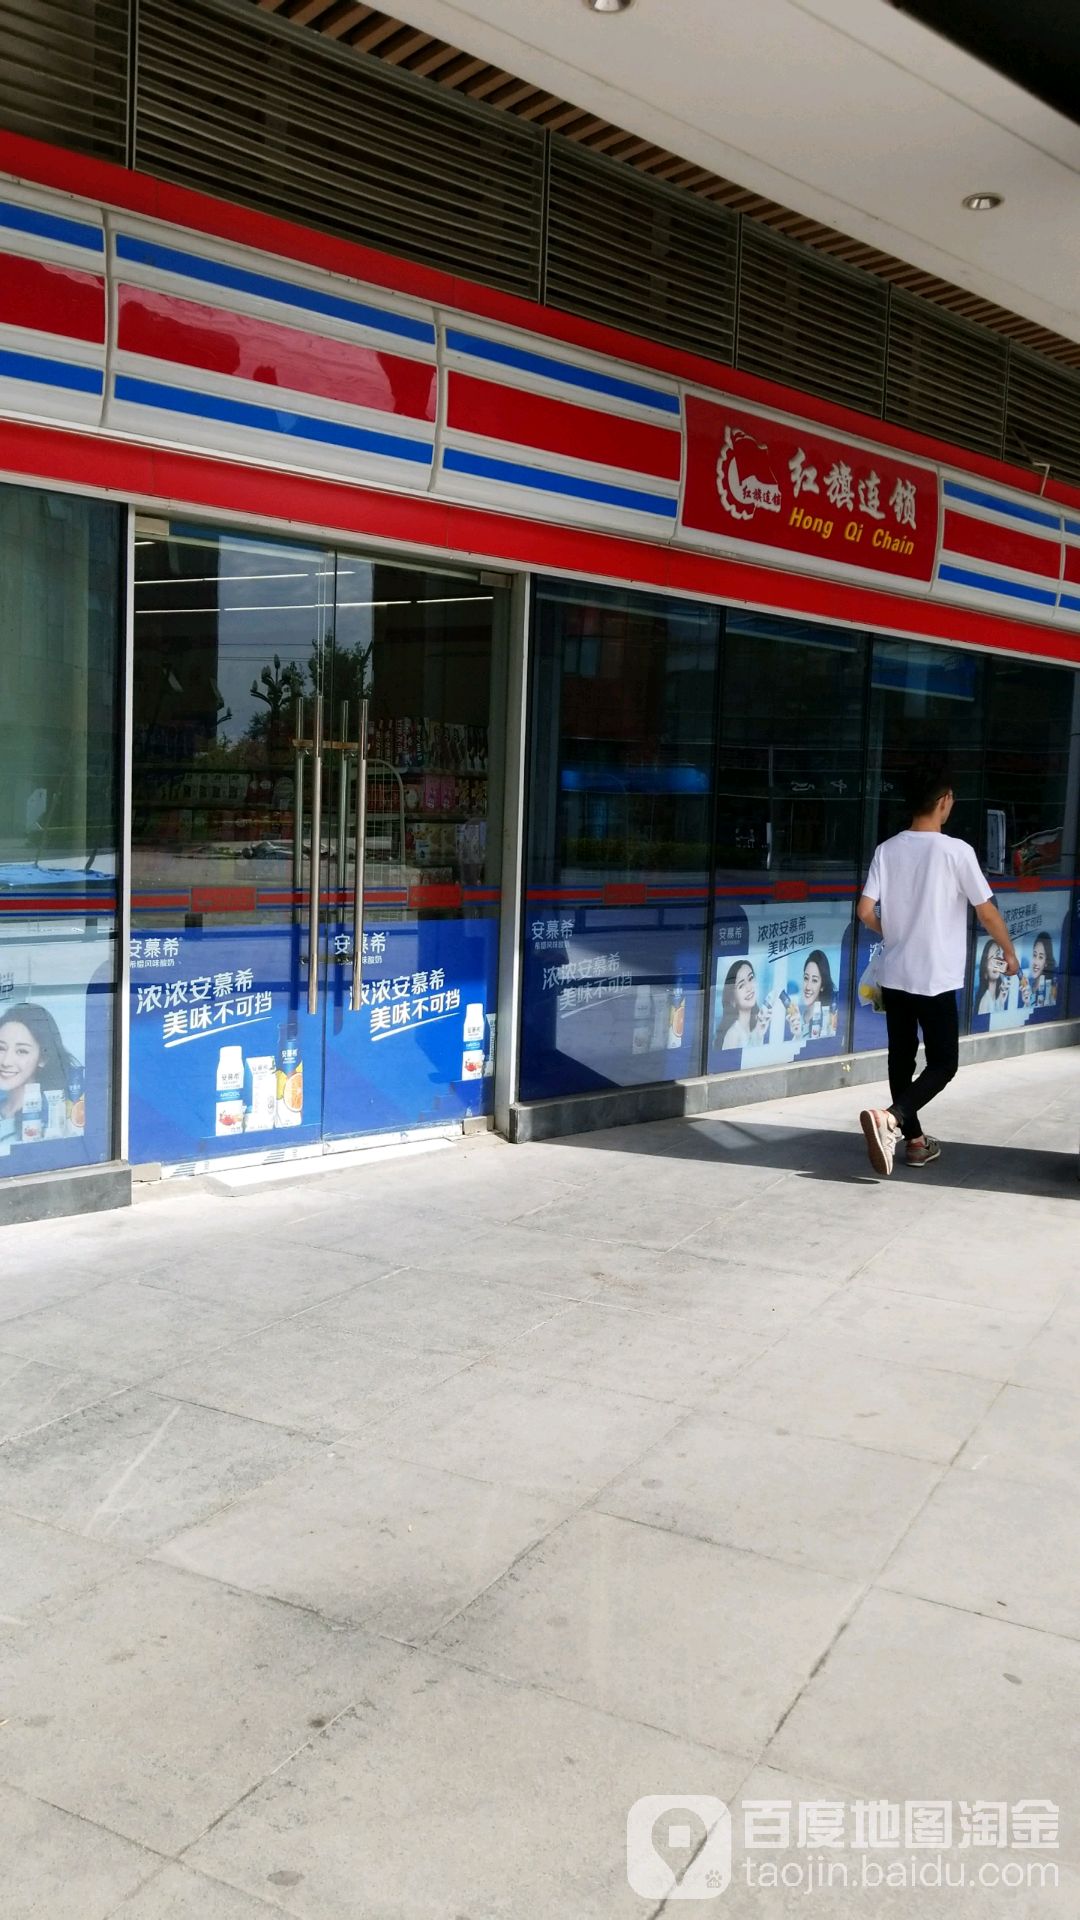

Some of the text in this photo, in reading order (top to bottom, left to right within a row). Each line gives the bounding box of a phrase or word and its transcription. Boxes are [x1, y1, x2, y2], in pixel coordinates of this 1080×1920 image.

[788, 446, 917, 530] 红旗连锁
[788, 506, 915, 556] Hong Qi Chain
[129, 937, 179, 959] 安慕希
[532, 919, 574, 940] 安慕希
[718, 926, 742, 941] 安慕希
[757, 915, 808, 943] 浓浓安慕希
[768, 931, 814, 957] 美味不可挡
[136, 967, 254, 1015] 浓浓安慕希
[542, 952, 620, 991] 浓浓安慕希
[559, 970, 633, 1011] 美味不可挡
[162, 990, 272, 1039] 美味不可挡
[370, 989, 460, 1034] 美味不可挡
